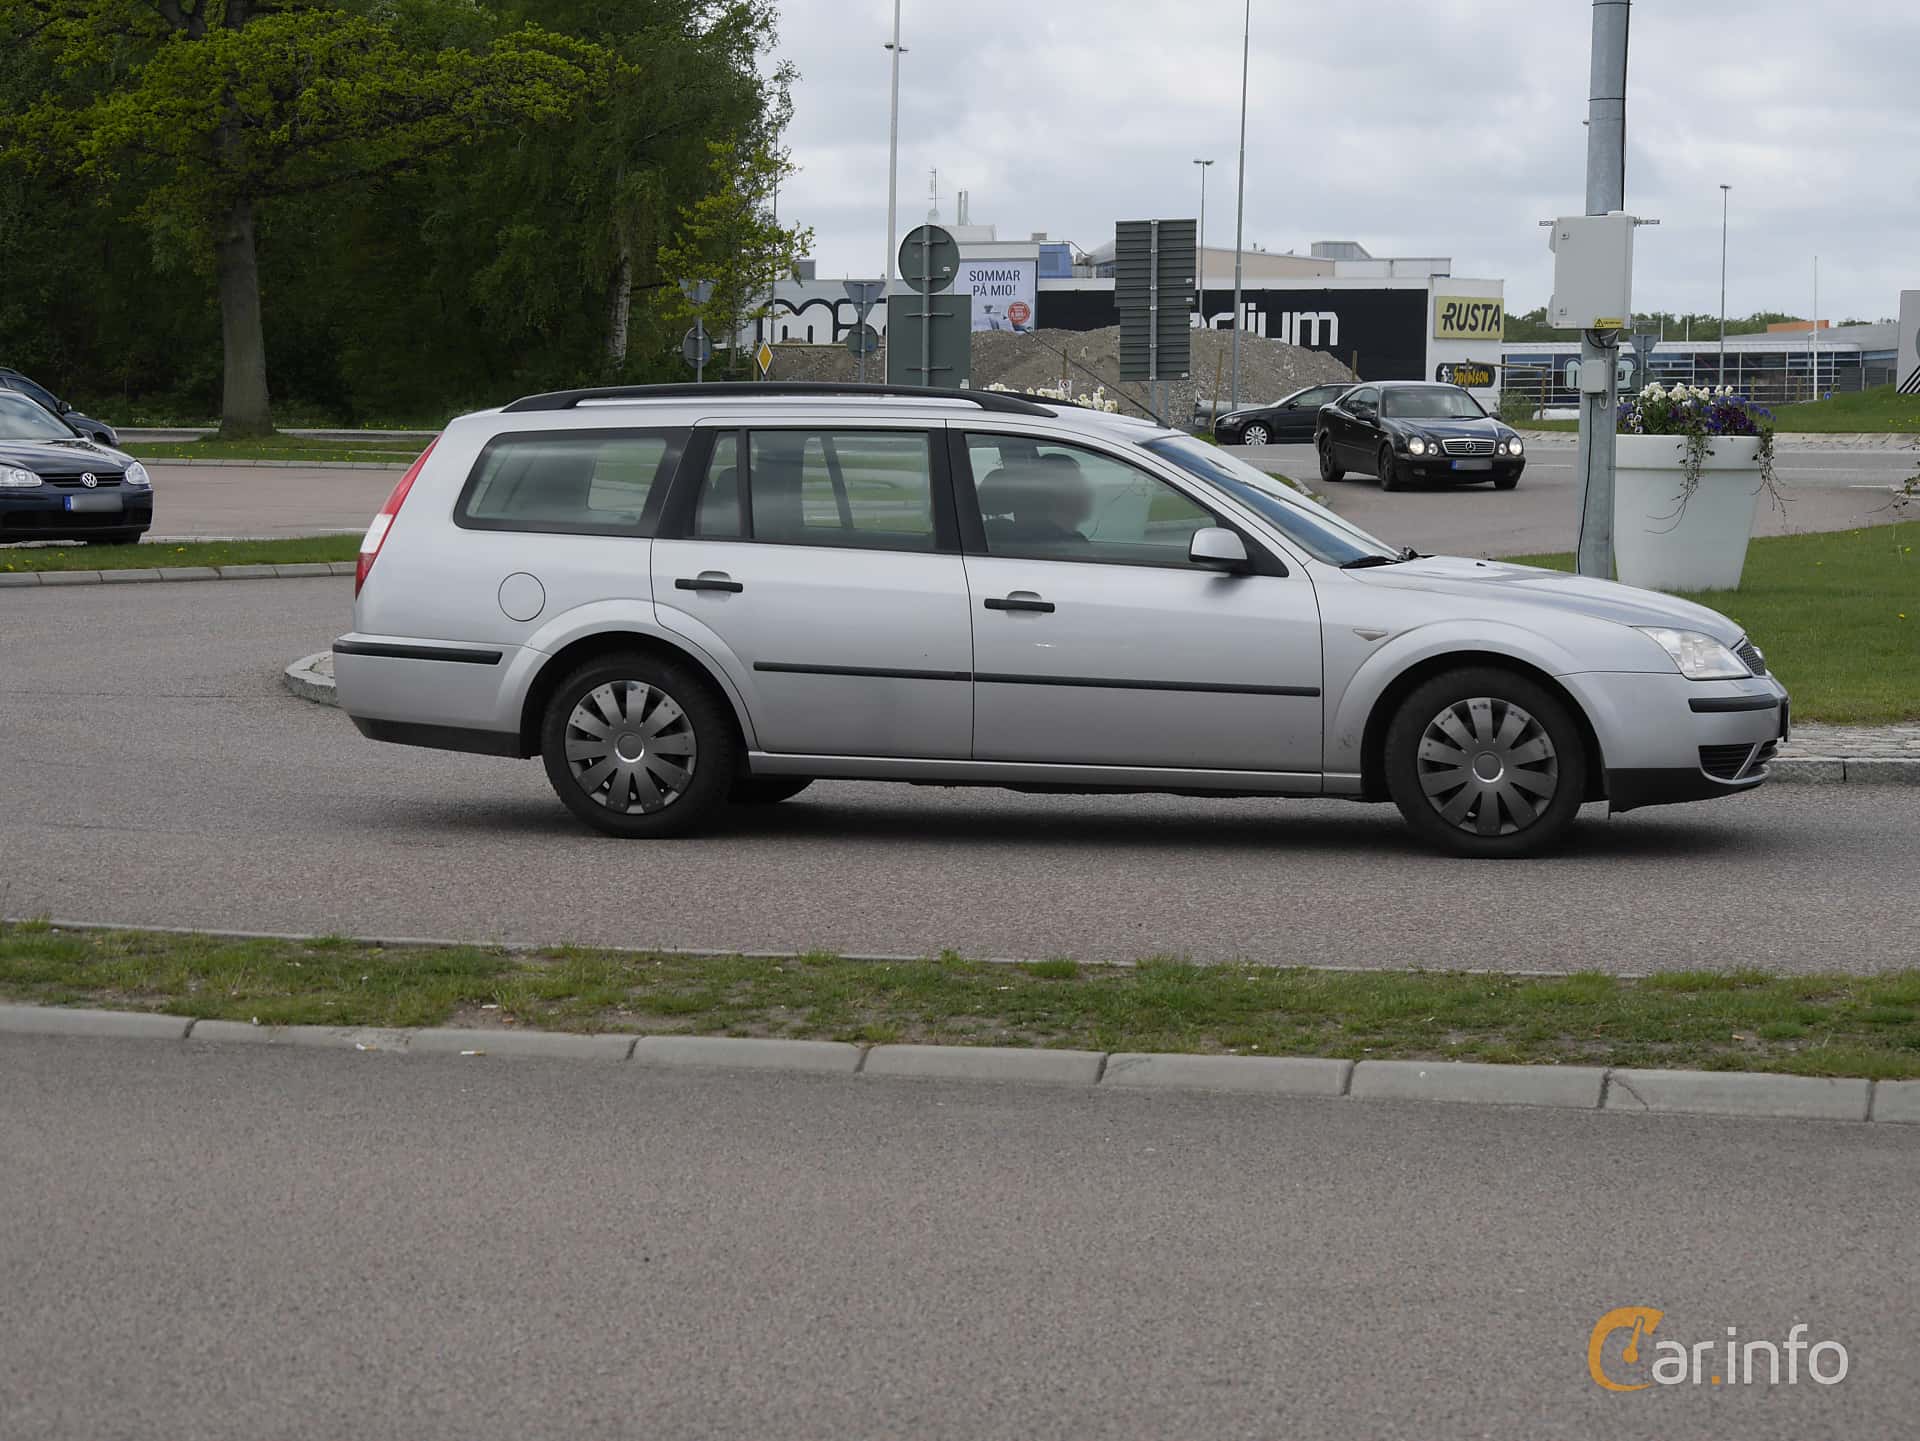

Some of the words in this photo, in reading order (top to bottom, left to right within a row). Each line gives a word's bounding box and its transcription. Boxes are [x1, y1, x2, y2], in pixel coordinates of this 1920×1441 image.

[969, 270, 1021, 281] SOMMAR
[972, 283, 987, 296] PÅ
[991, 285, 1016, 296] MIO!
[1441, 302, 1501, 332] RUSTA
